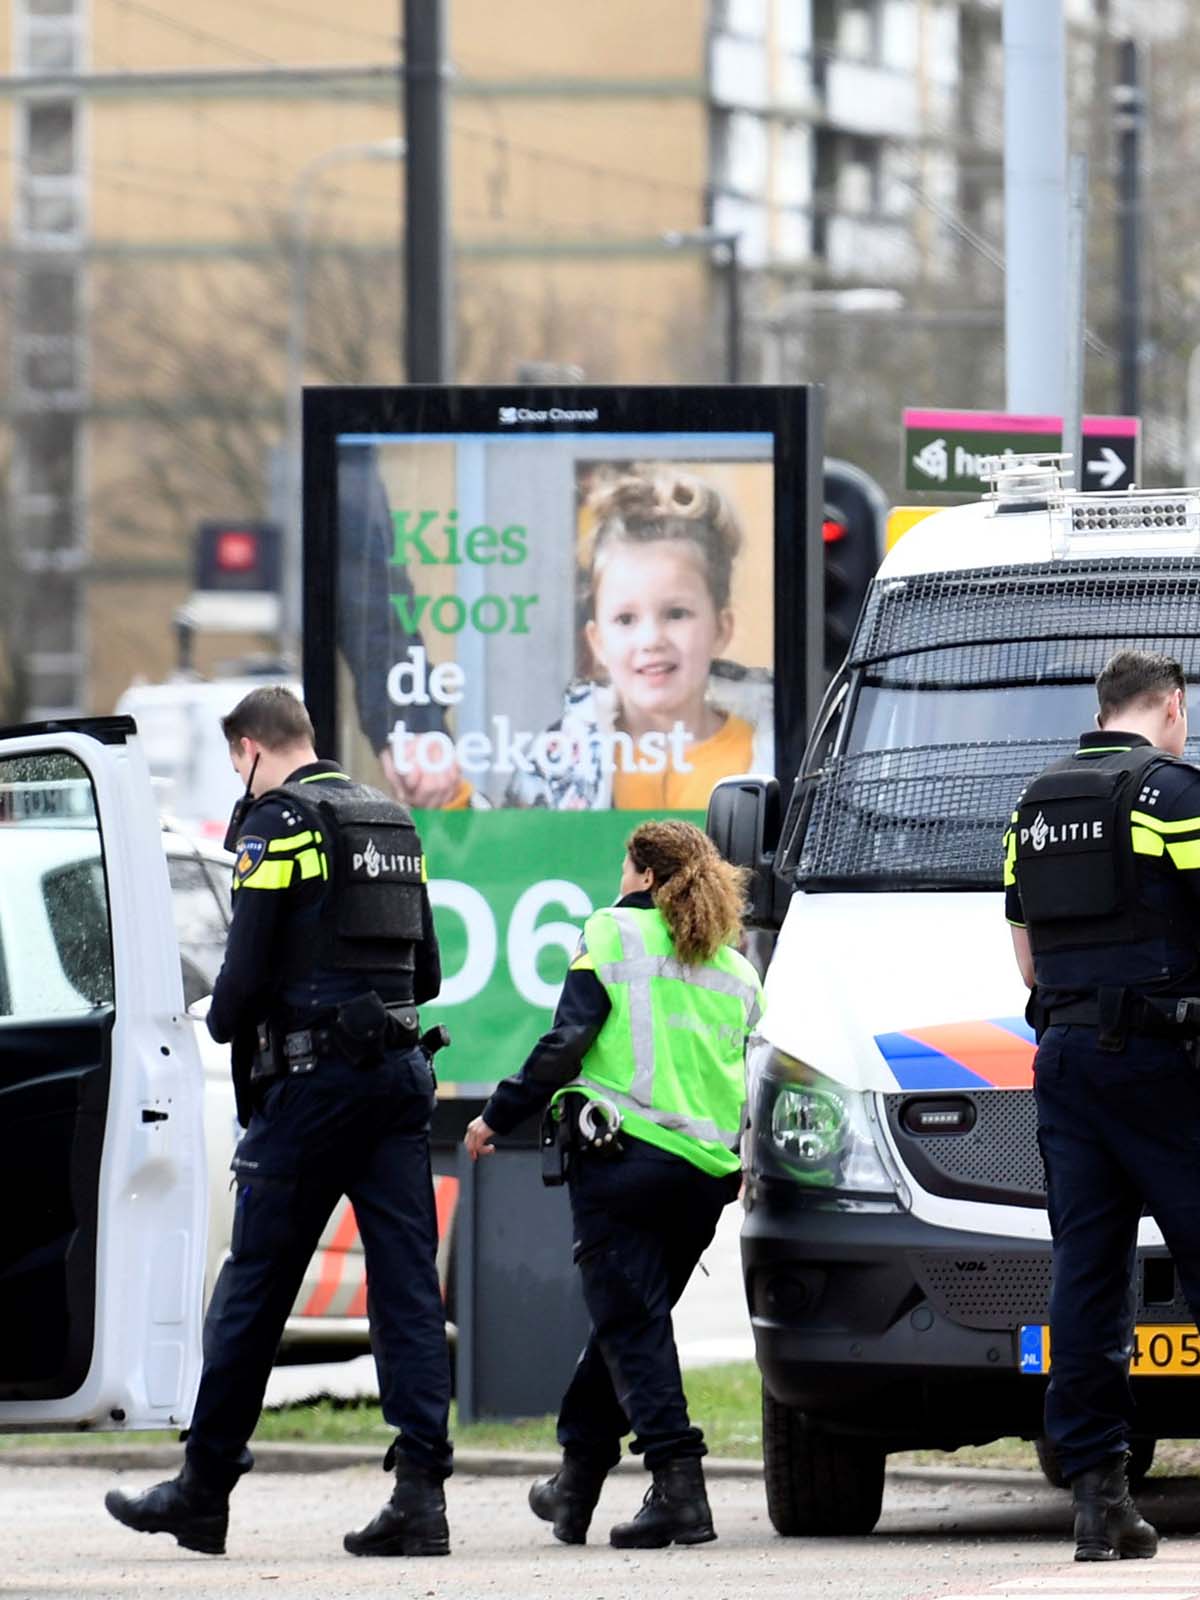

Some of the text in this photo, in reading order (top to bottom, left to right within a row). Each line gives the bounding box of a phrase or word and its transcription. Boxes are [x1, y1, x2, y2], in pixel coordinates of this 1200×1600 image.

[390, 511, 528, 566] Kies
[389, 593, 539, 635] voor
[387, 645, 465, 705] de
[387, 715, 694, 774] toekomst
[1021, 810, 1103, 851] POLITIE
[353, 838, 421, 877] POLITIE
[954, 1261, 987, 1271] VDL
[1022, 1353, 1040, 1365] NL
